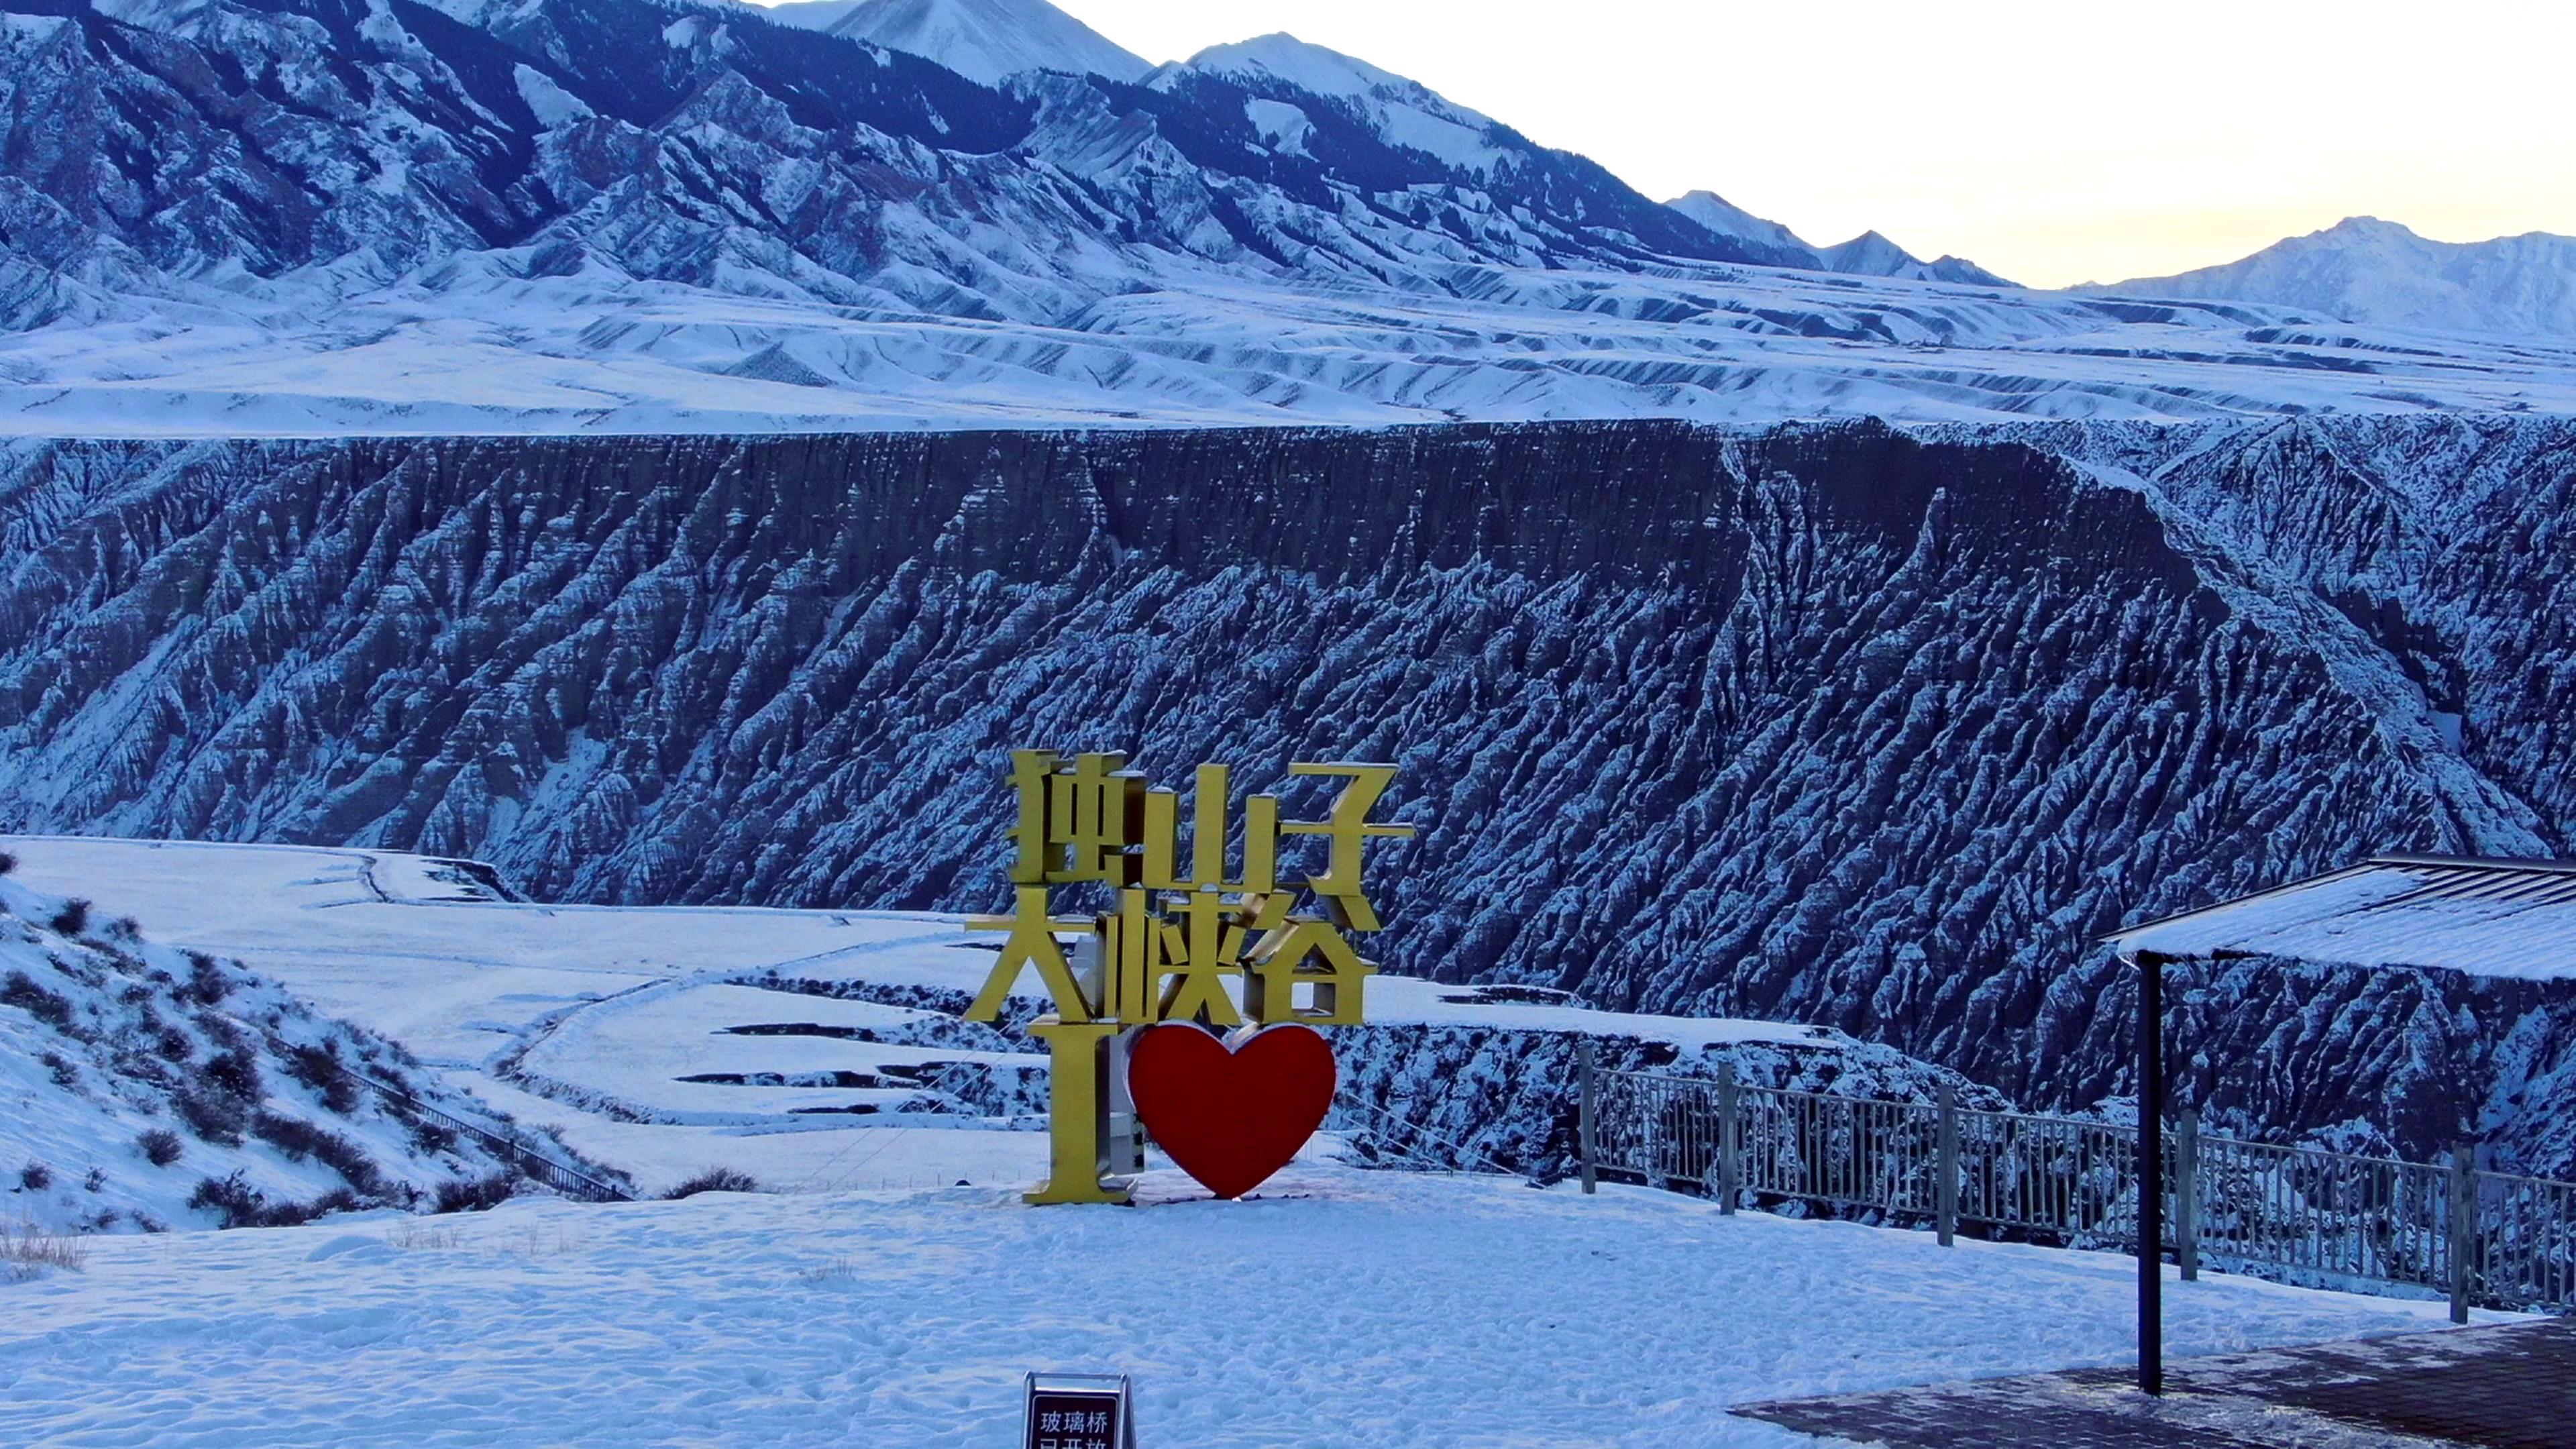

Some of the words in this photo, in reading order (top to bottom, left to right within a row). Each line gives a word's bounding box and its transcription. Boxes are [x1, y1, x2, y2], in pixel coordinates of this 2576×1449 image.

[1007, 749, 1415, 897] 独山子
[963, 886, 1382, 1025] 大峡谷
[1022, 1024, 1130, 1203] I
[1040, 1410, 1108, 1434] 玻璃桥
